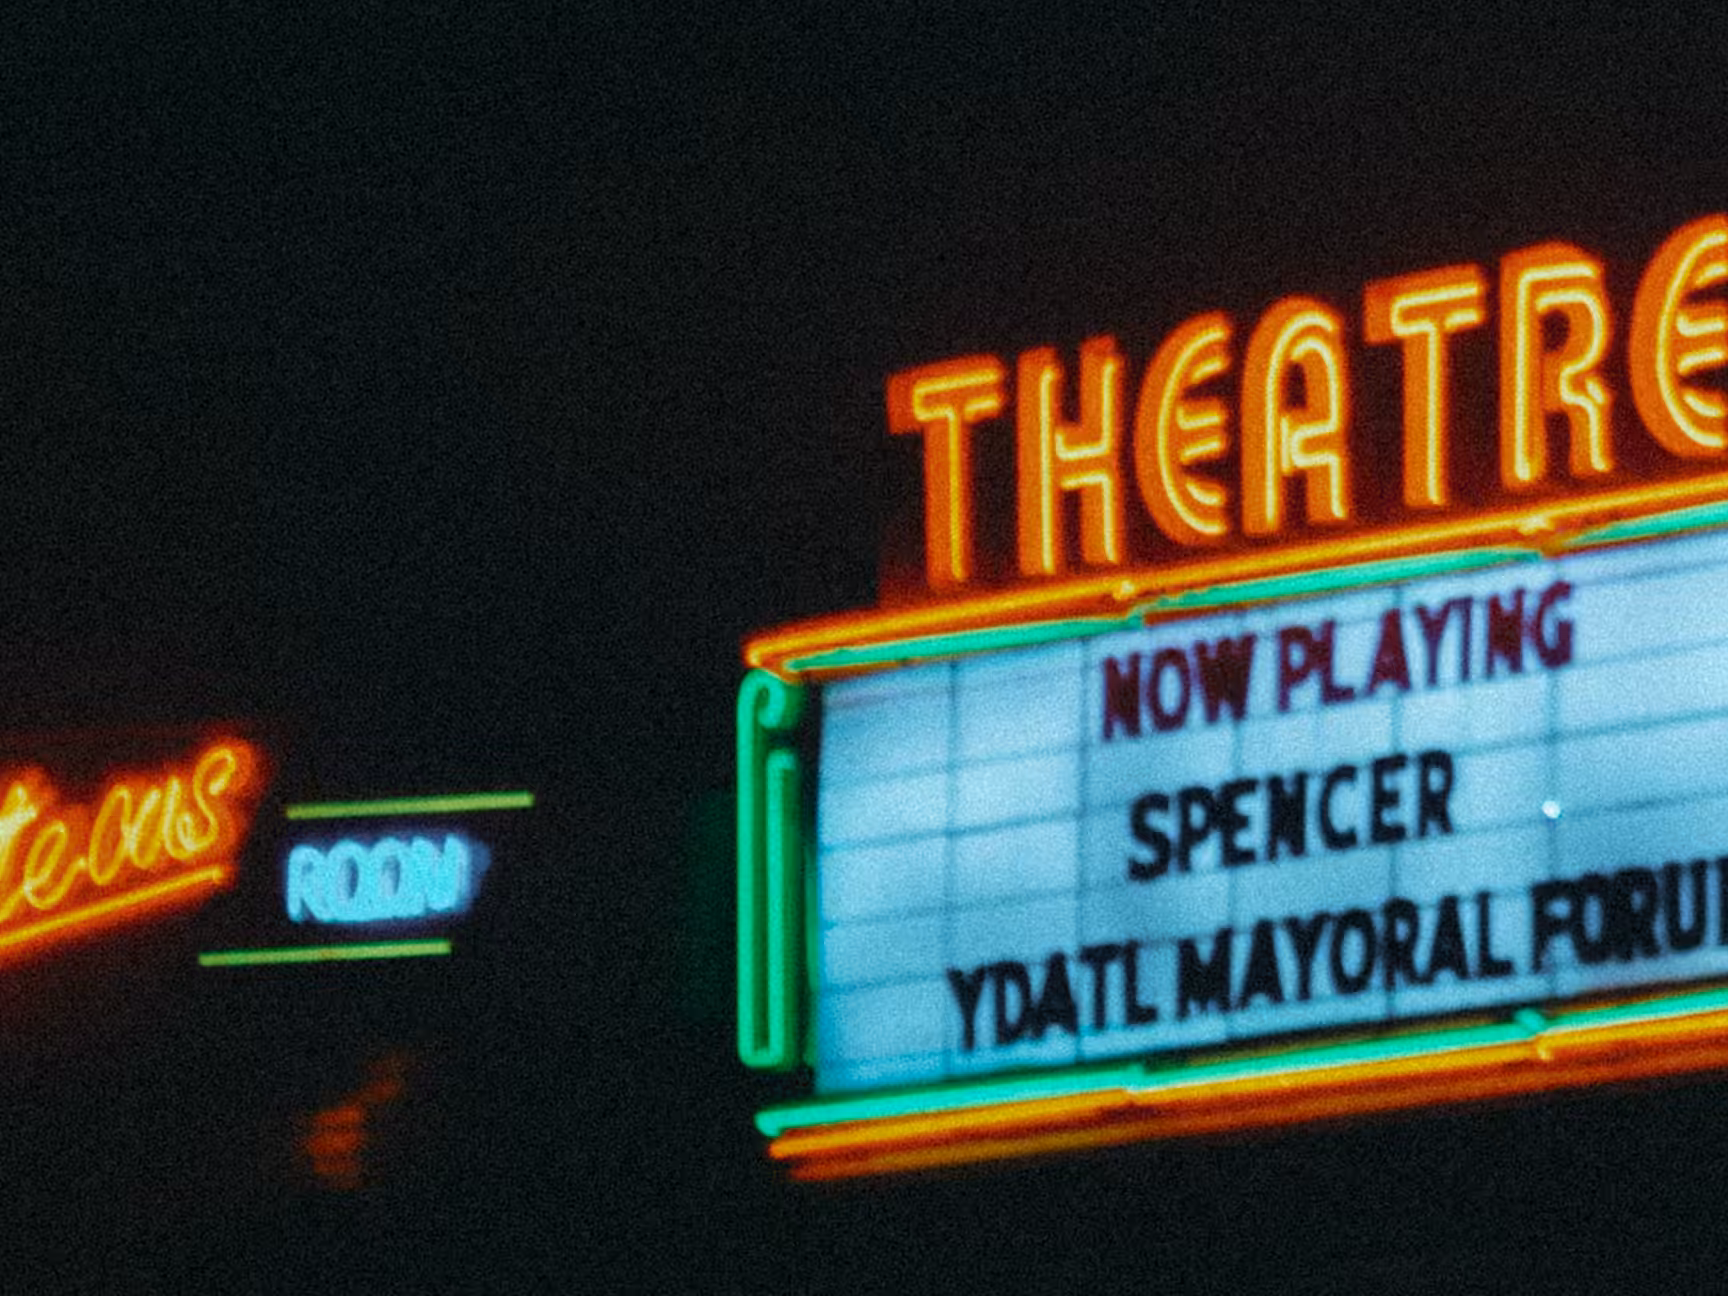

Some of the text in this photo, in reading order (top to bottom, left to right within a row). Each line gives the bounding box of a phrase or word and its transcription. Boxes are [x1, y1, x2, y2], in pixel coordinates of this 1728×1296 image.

[1101, 581, 1575, 742] NOW PLAYING
[1127, 750, 1457, 883] SPENCER
[947, 938, 1158, 1052] YDATL
[1176, 890, 1514, 1019] MAYORAL
